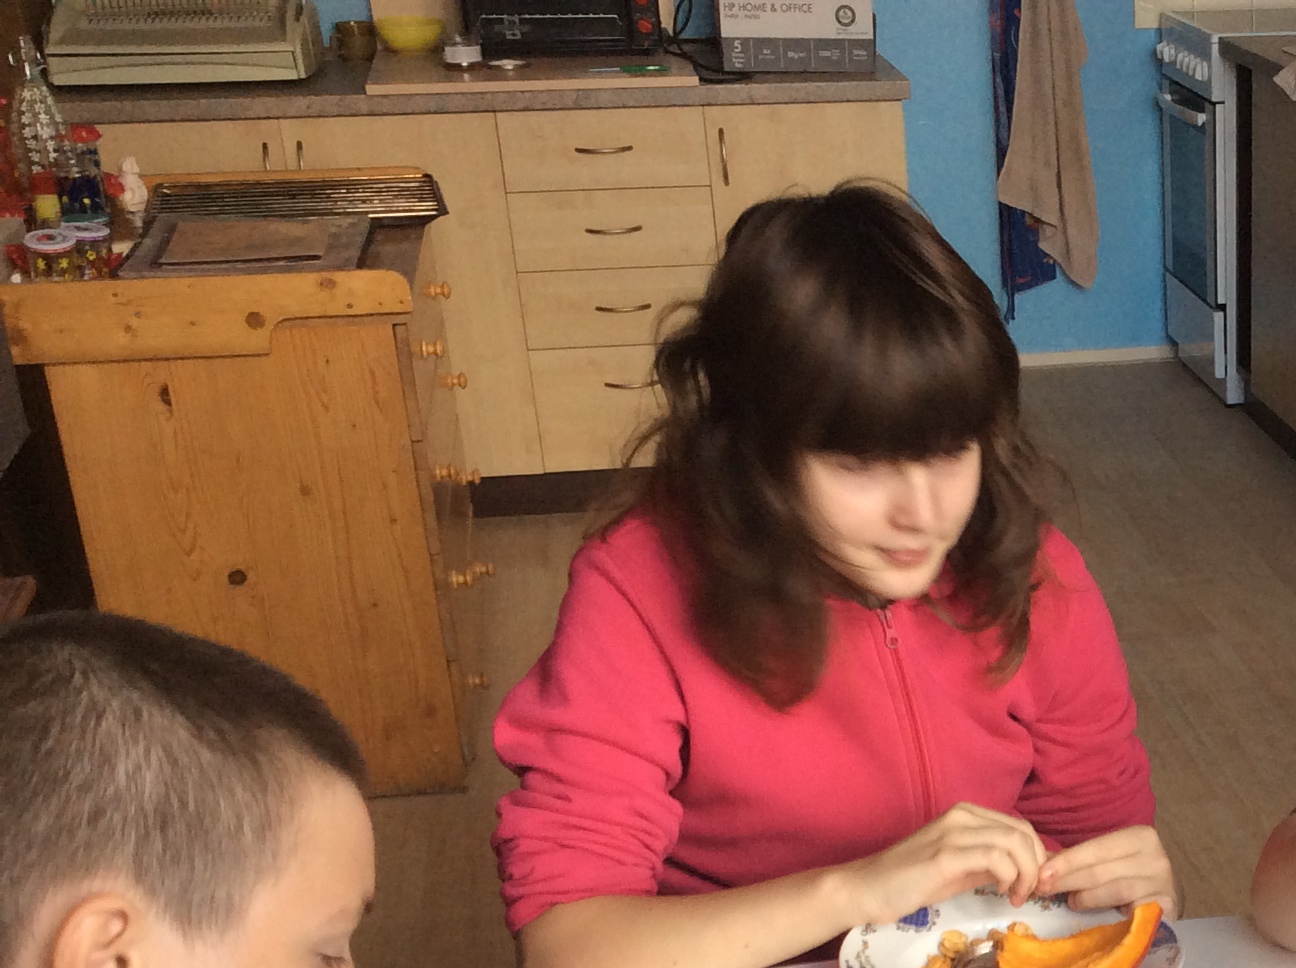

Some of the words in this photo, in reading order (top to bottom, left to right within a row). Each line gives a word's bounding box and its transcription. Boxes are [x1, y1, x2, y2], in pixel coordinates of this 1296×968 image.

[723, 2, 736, 12] HP
[738, 3, 768, 13] HOME
[770, 3, 778, 13] &
[780, 3, 813, 13] OFFICE
[733, 40, 742, 52] 5
